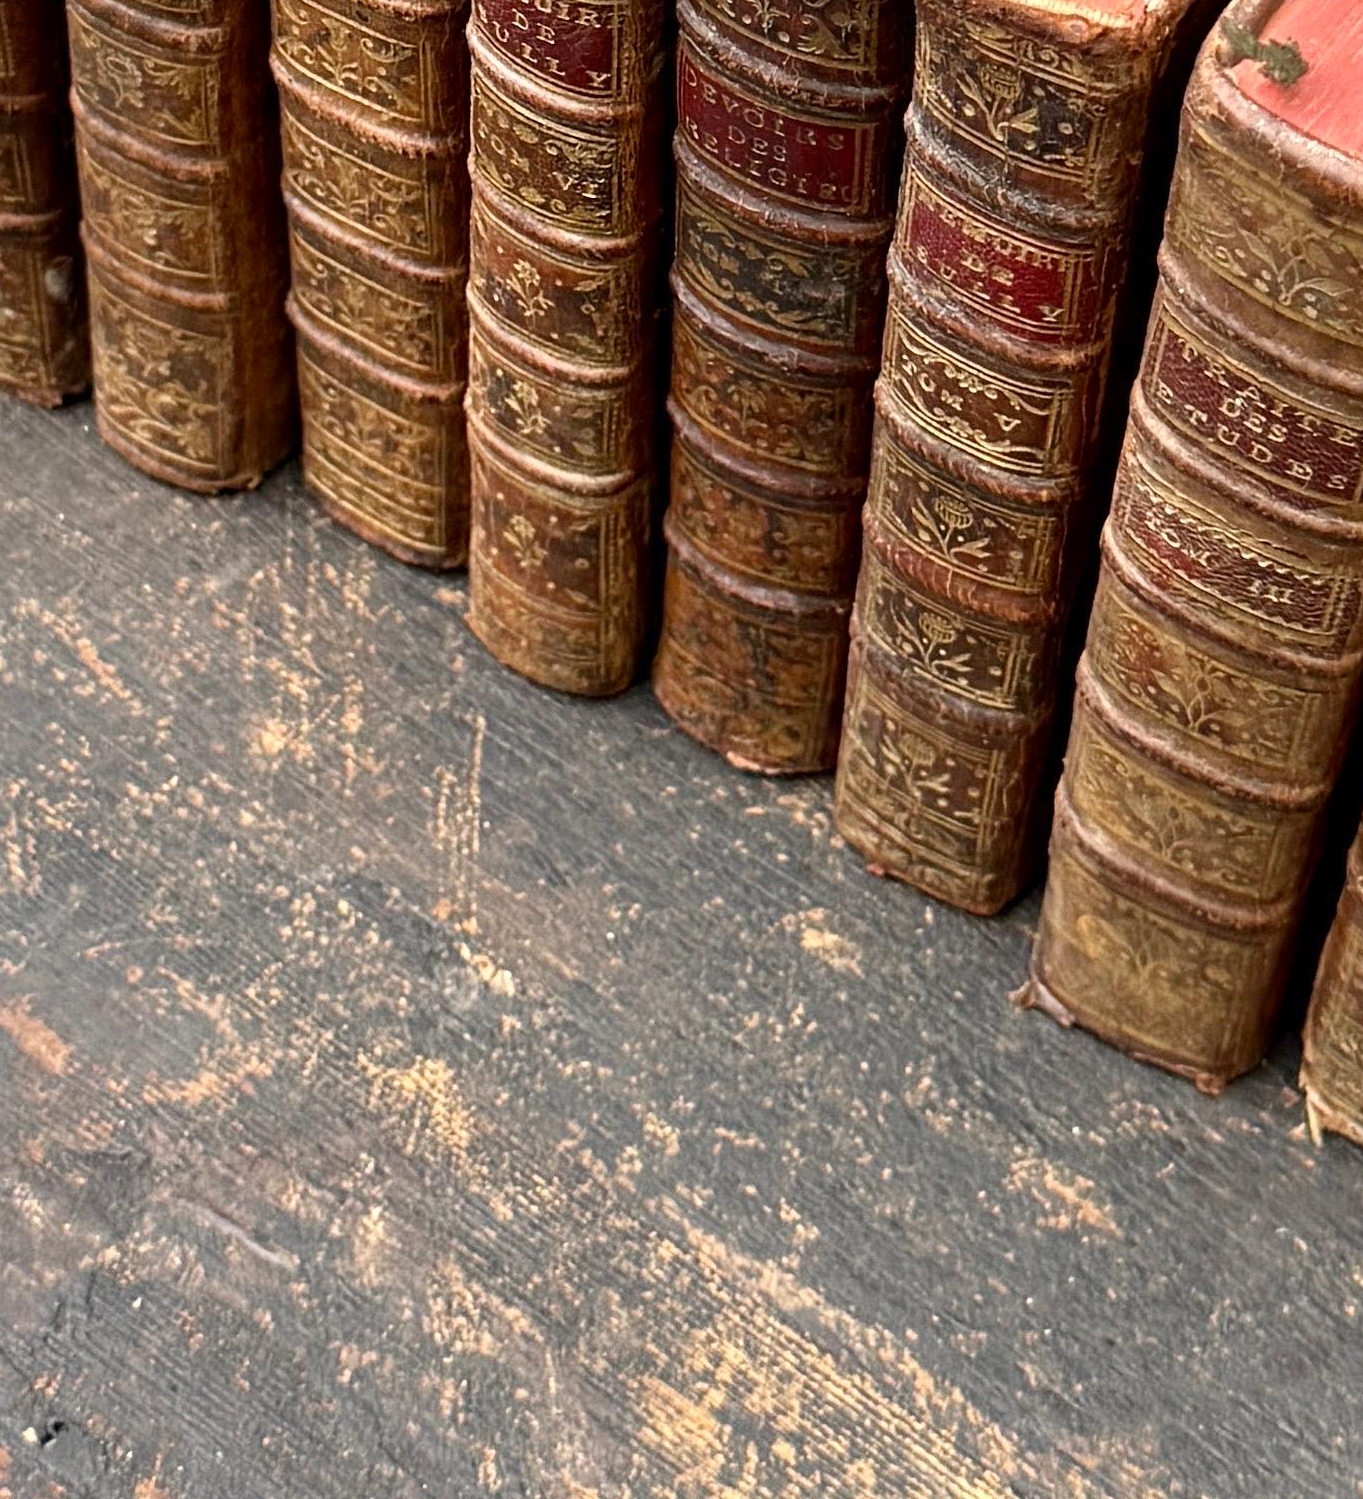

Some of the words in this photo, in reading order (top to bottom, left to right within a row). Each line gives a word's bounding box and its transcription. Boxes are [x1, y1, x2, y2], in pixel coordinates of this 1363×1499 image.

[477, 2, 612, 89] SULLY
[511, 7, 556, 45] DE
[685, 66, 844, 151] DEVOIRS
[728, 124, 787, 162] DES
[916, 245, 1065, 323] SULLY
[901, 354, 964, 412] TOM
[1156, 377, 1349, 491] ETUDES
[1219, 394, 1288, 444] DES
